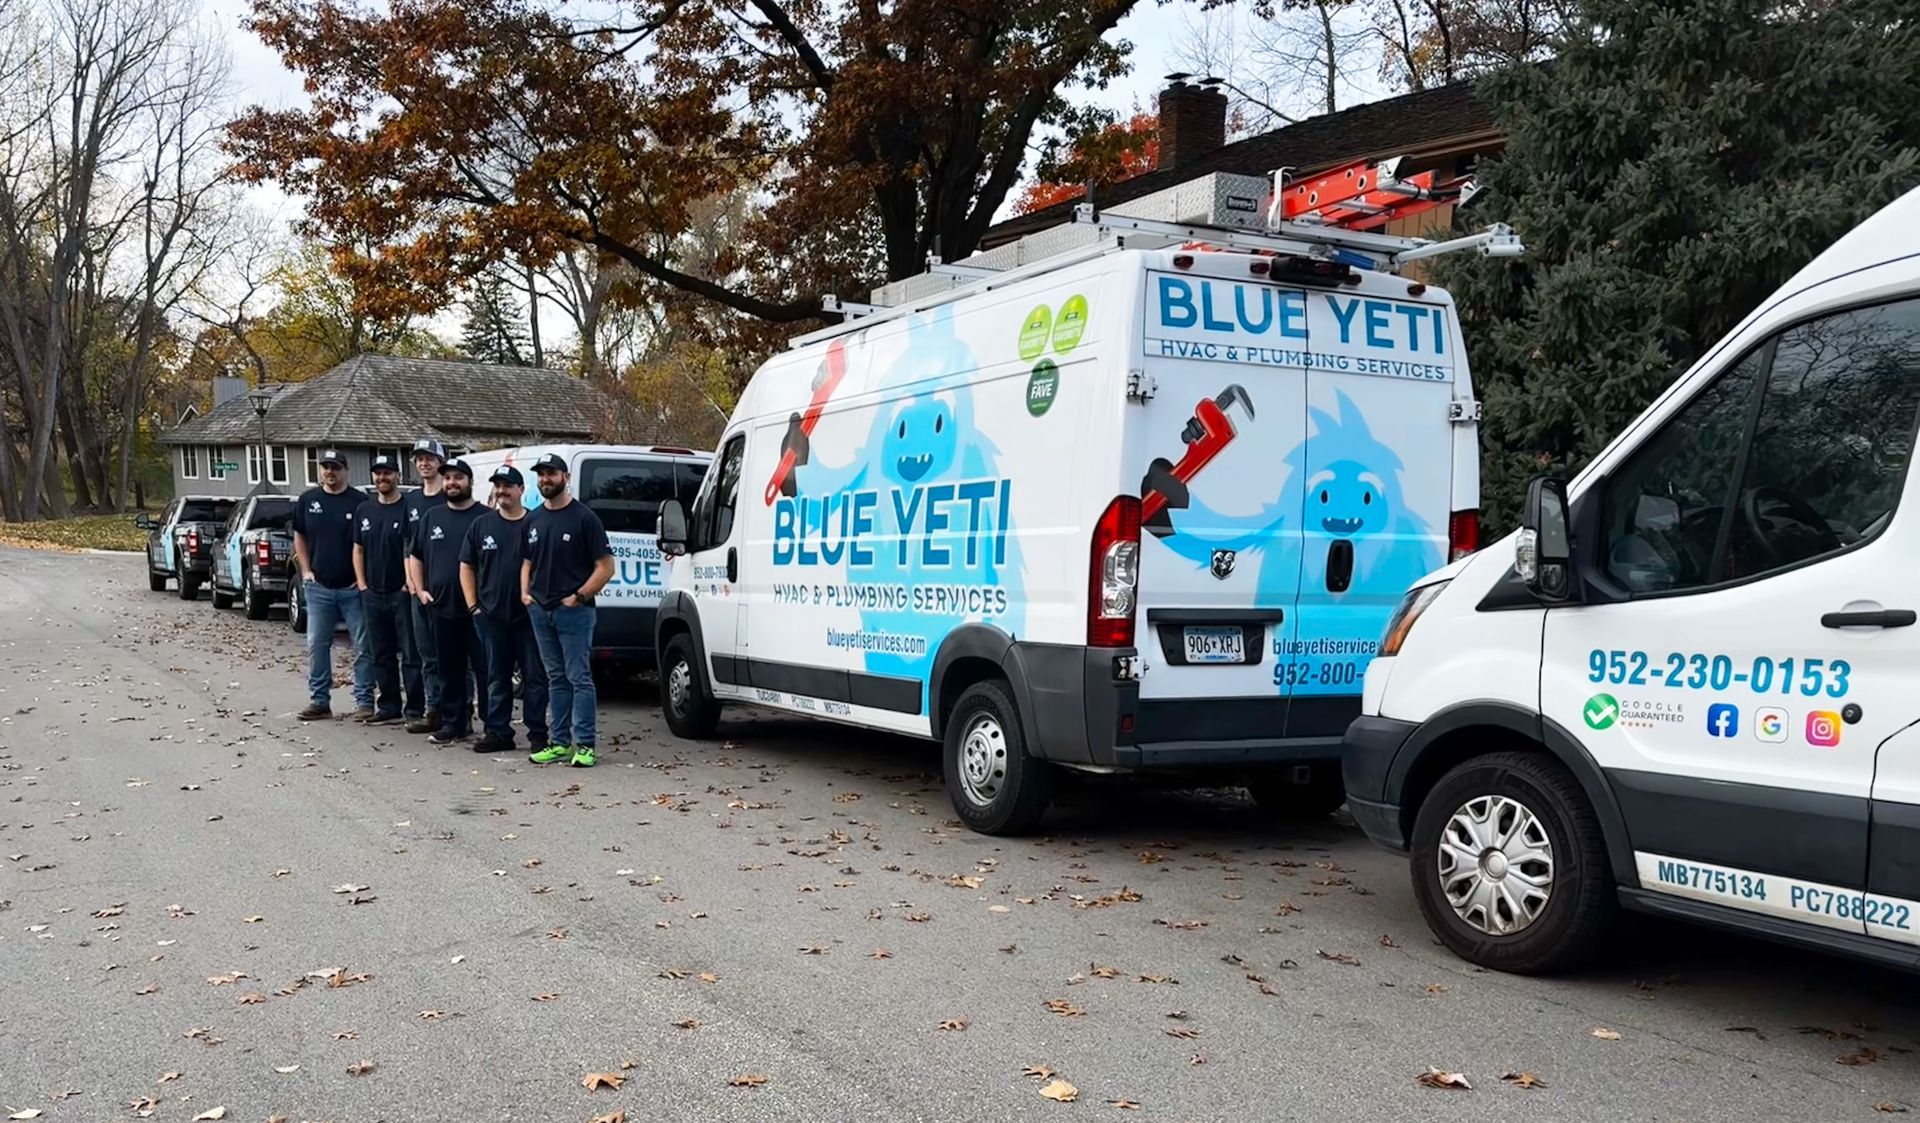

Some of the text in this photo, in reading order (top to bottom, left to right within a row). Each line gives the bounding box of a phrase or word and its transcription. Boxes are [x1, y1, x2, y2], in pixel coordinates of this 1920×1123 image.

[1158, 277, 1444, 355] BLUE YETI
[1161, 339, 1446, 380] HVAC & PLUMBING SERVICES
[1030, 383, 1054, 400] FAVE
[773, 479, 1011, 566] BLUE YETI
[773, 583, 1007, 614] HVAC & PLUMBING SERVICES
[826, 627, 926, 654] blueyetiservices.com
[1188, 635, 1241, 654] 906 XRJ
[1272, 637, 1379, 658] blueyetiservice
[1272, 661, 1370, 686] 952-800-
[1588, 648, 1852, 699] 952-230-0153
[1620, 710, 1685, 723] GUARANTEED
[1621, 700, 1684, 712] GOOGLE
[1657, 858, 1767, 901] MB775134
[1790, 884, 1911, 930] PC788222
